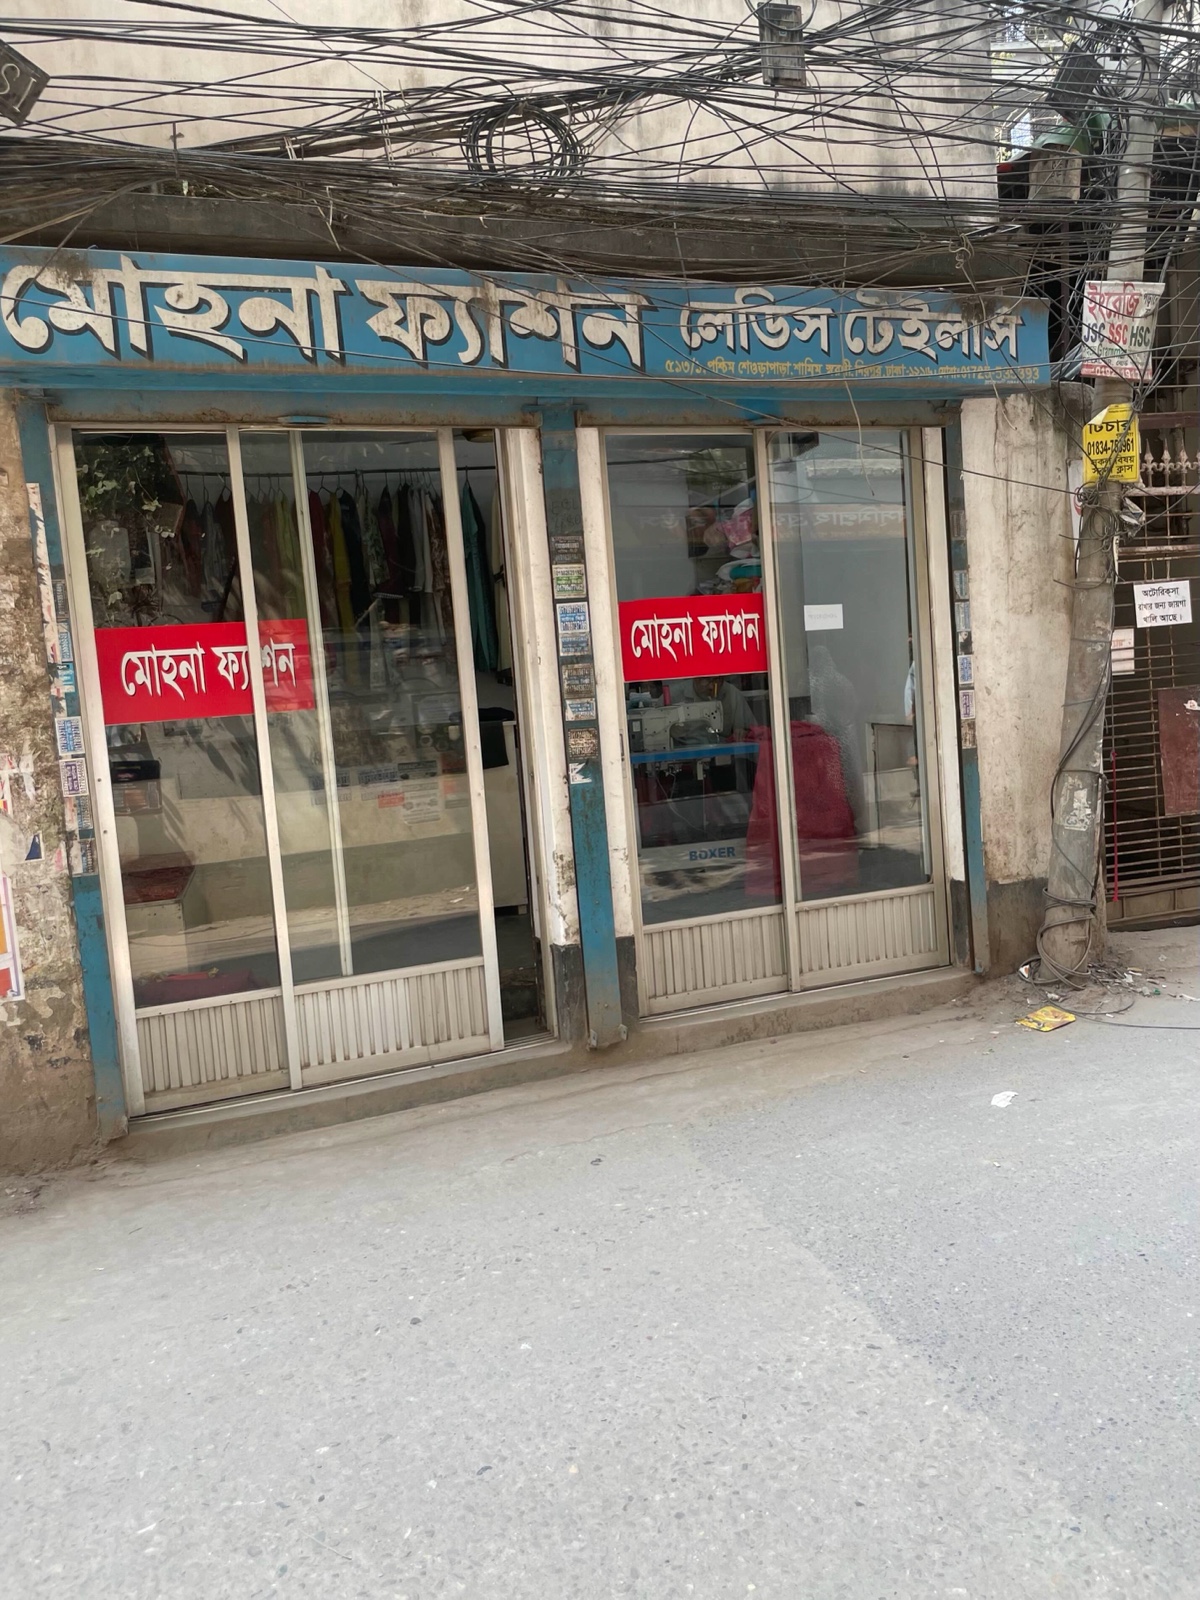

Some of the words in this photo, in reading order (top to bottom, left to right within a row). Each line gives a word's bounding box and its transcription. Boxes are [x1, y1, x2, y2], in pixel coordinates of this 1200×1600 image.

[1, 253, 347, 363] মোহনা
[356, 278, 650, 372] ফ্যাশন
[680, 287, 835, 355] লেডিস
[845, 291, 1022, 361] টেইলার্স
[1087, 282, 1142, 321] ইংরেজি
[1083, 322, 1105, 343] JSC
[1108, 322, 1128, 344] SSC
[1130, 325, 1151, 347] HSC
[1154, 602, 1166, 610] জন্য
[631, 612, 693, 662] মোহনা
[698, 609, 760, 654] ফ্যাশন
[121, 641, 205, 700] মোহনা
[689, 847, 735, 861] BOXER
